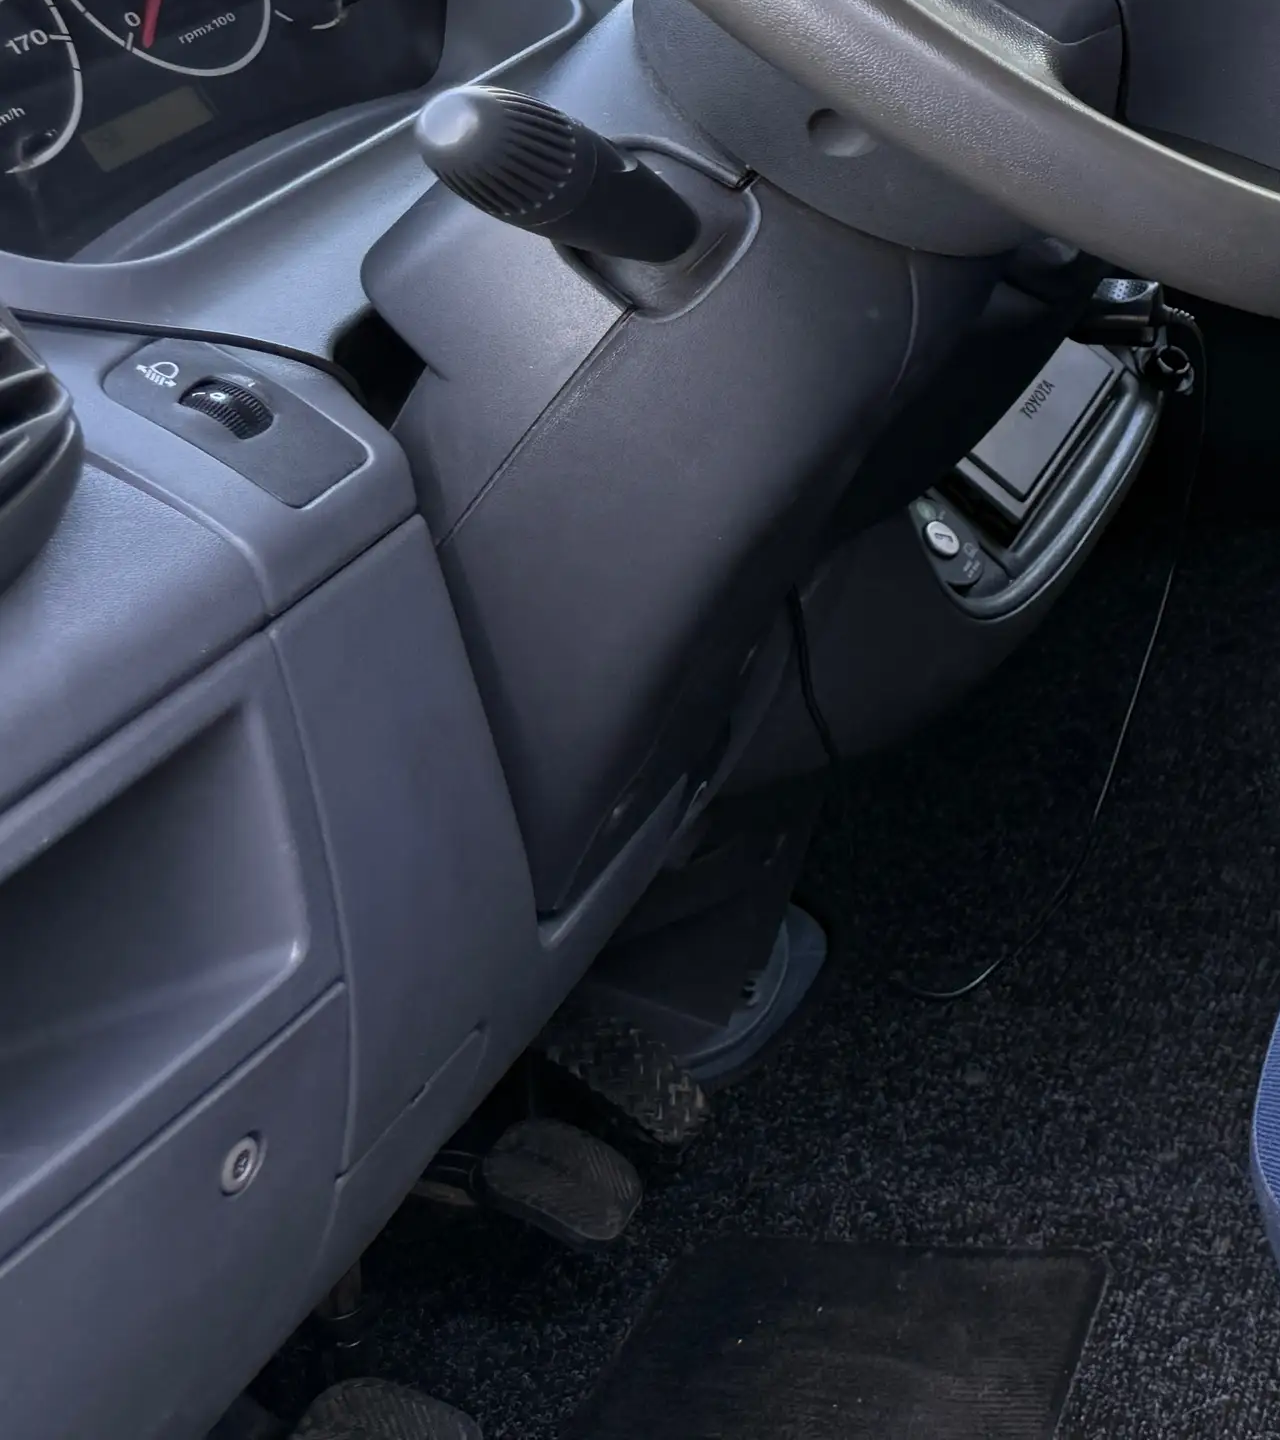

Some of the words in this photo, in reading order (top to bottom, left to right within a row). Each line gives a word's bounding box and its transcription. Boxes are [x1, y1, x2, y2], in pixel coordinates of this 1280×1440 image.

[124, 11, 141, 27] 0
[178, 12, 236, 45] rpmx100
[5, 29, 48, 54] 170
[1019, 378, 1056, 420] TOYOTA
